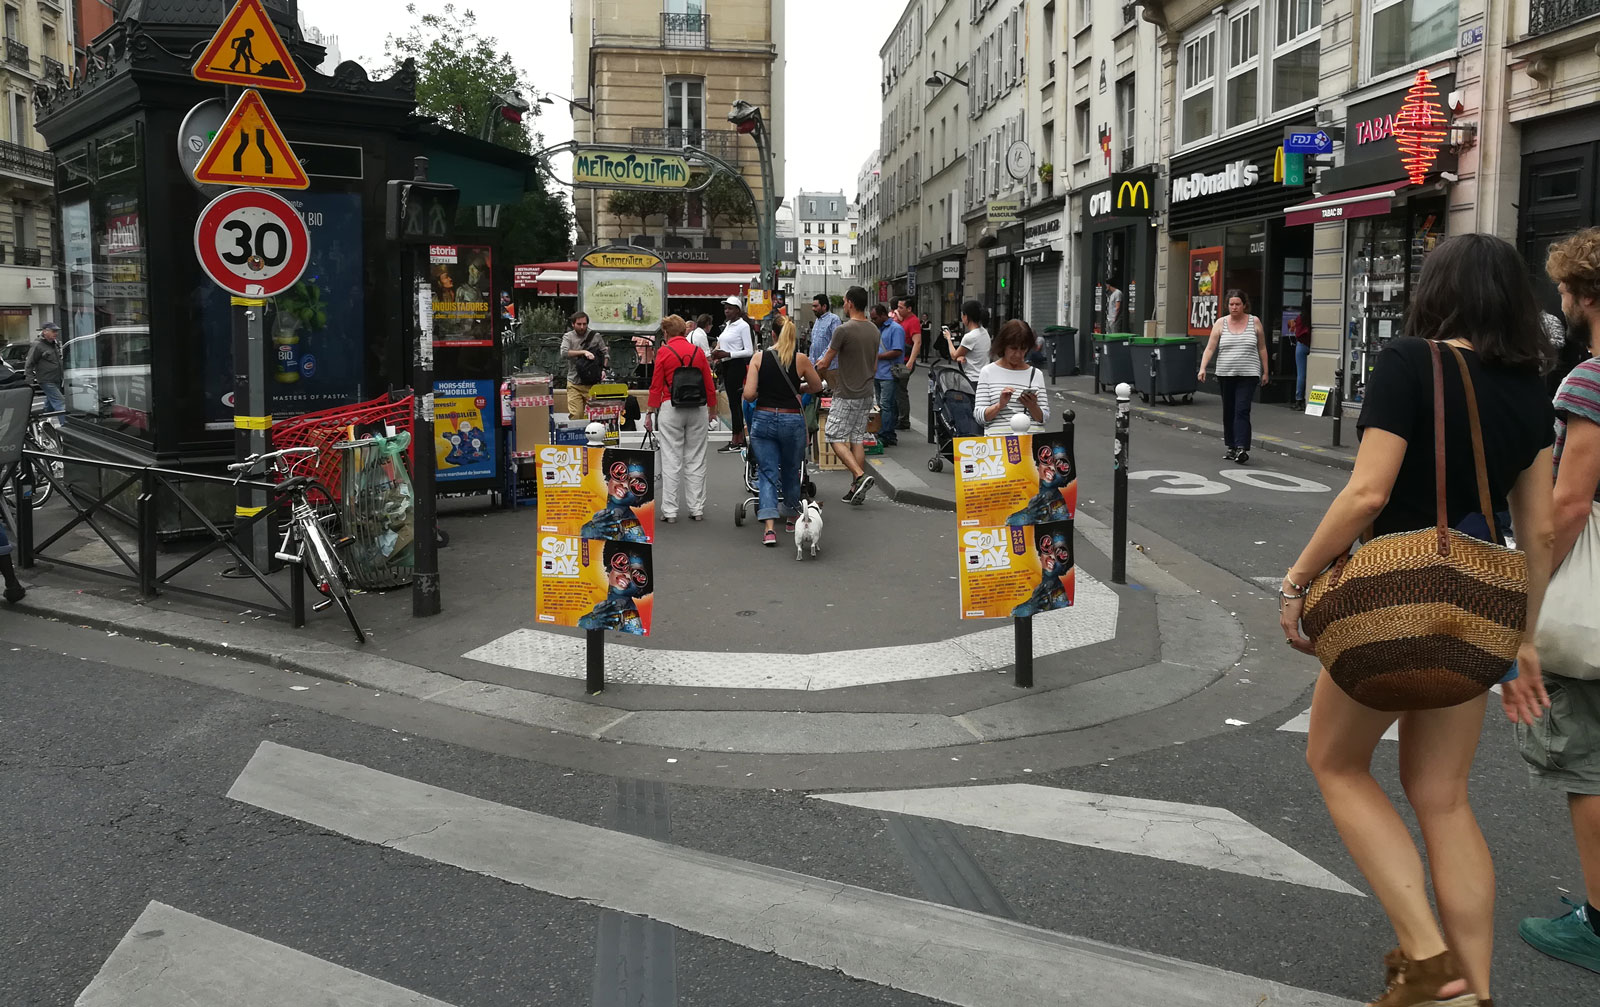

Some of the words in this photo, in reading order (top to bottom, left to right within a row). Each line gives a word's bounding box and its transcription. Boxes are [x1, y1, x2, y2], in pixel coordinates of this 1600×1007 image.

[1292, 135, 1311, 144] FDJ
[577, 154, 686, 183] METROPOLITAIN
[1172, 160, 1259, 203] McDonald's
[1322, 208, 1336, 218] TABAC
[308, 212, 323, 226] BIO
[222, 220, 287, 266] 30
[602, 255, 643, 266] PARMENTIER
[677, 251, 709, 261] SOLEIL
[278, 351, 293, 360] BIO
[438, 381, 476, 389] HORS-SÉRIE
[559, 432, 566, 441] Le
[1007, 439, 1018, 447] 22
[975, 445, 986, 456] 20
[1008, 446, 1019, 454] 24
[556, 453, 567, 464] 20
[1128, 469, 1331, 495] 30
[1012, 530, 1023, 538] 22
[980, 535, 992, 546] 20
[1013, 537, 1024, 545] 24
[555, 543, 565, 554] 20
